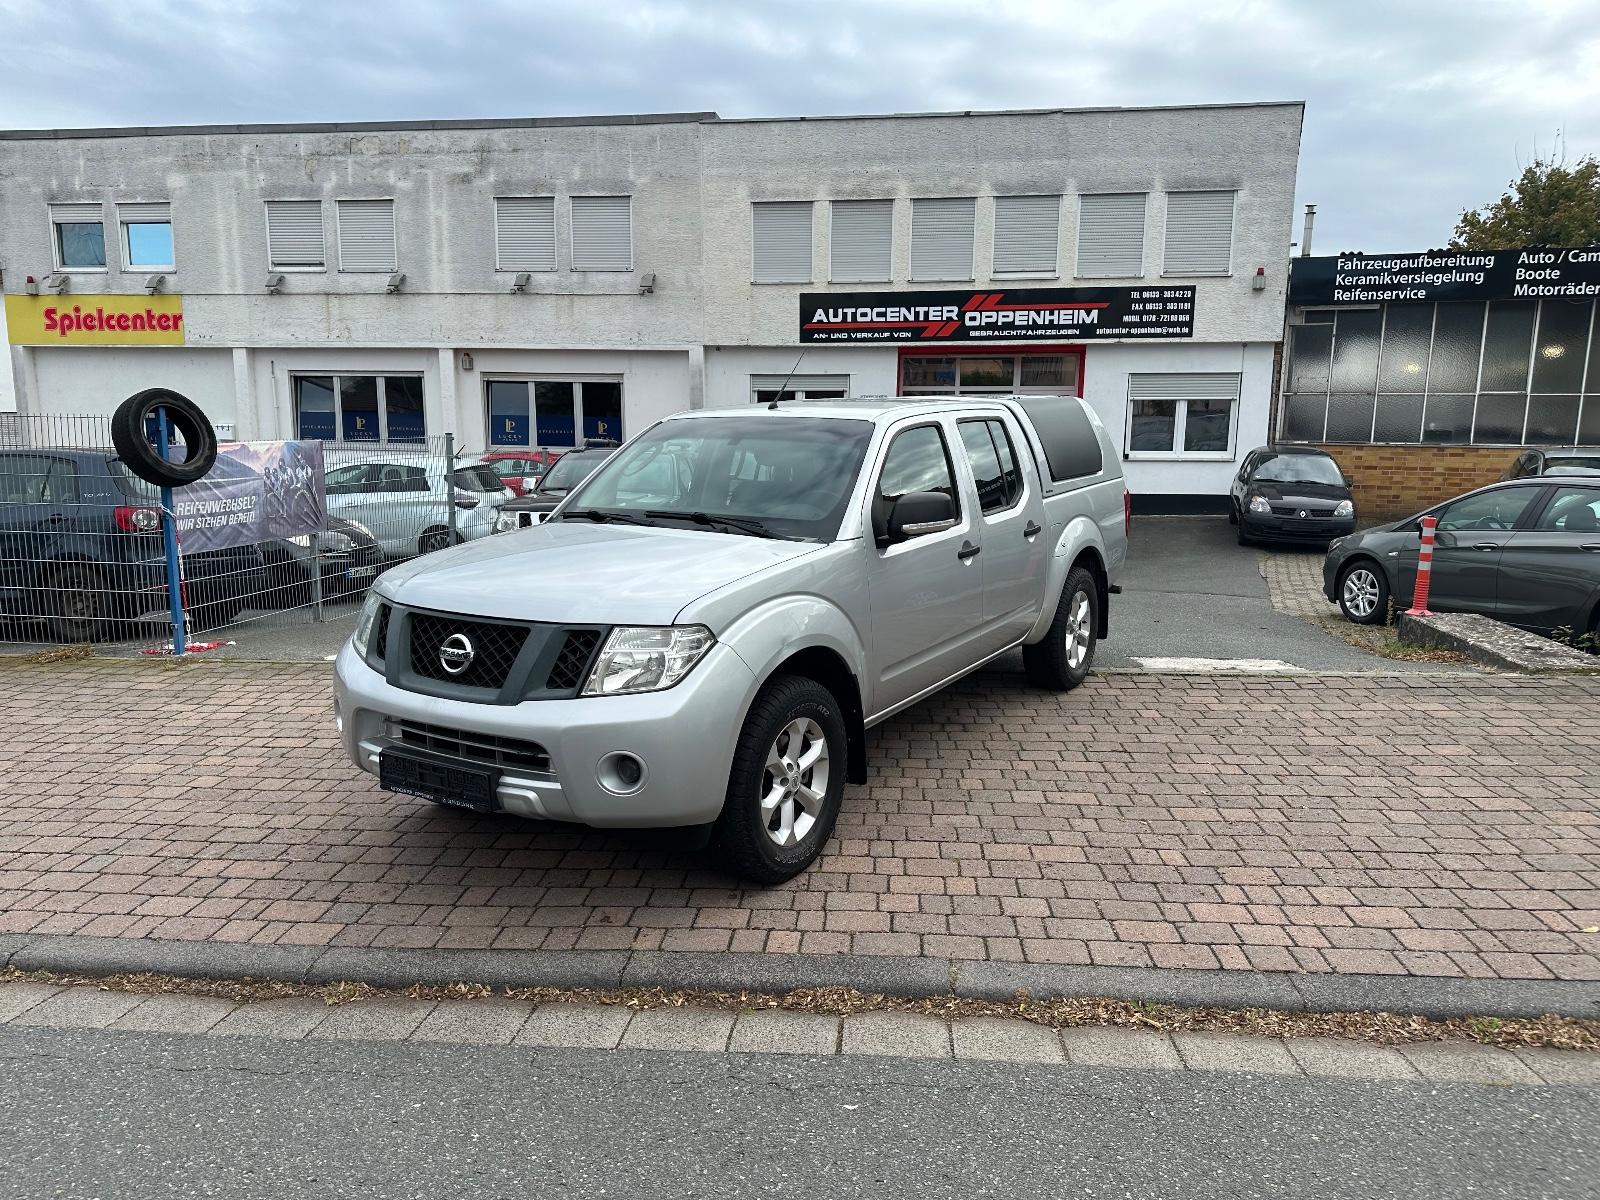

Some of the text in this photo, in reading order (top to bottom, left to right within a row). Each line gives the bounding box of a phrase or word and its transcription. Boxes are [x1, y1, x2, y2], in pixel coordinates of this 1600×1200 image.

[1337, 254, 1495, 271] Fahrzeugaufbereitung
[1517, 251, 1555, 265] Auto
[1335, 270, 1485, 286] Keramikversiegelung
[1515, 267, 1561, 280] Boote
[1333, 288, 1426, 301] Reifenservice
[1513, 282, 1600, 297] Motorräder
[42, 305, 184, 337] Spielcenter
[812, 306, 1099, 326] AUTOCENTER OPPENHEIM
[969, 328, 1080, 337] GEBRAUCHTFAHRZEUGEN
[176, 495, 256, 516] REIFENWECHSEL?
[176, 518, 194, 531] WIR
[195, 515, 227, 529] STEHEN
